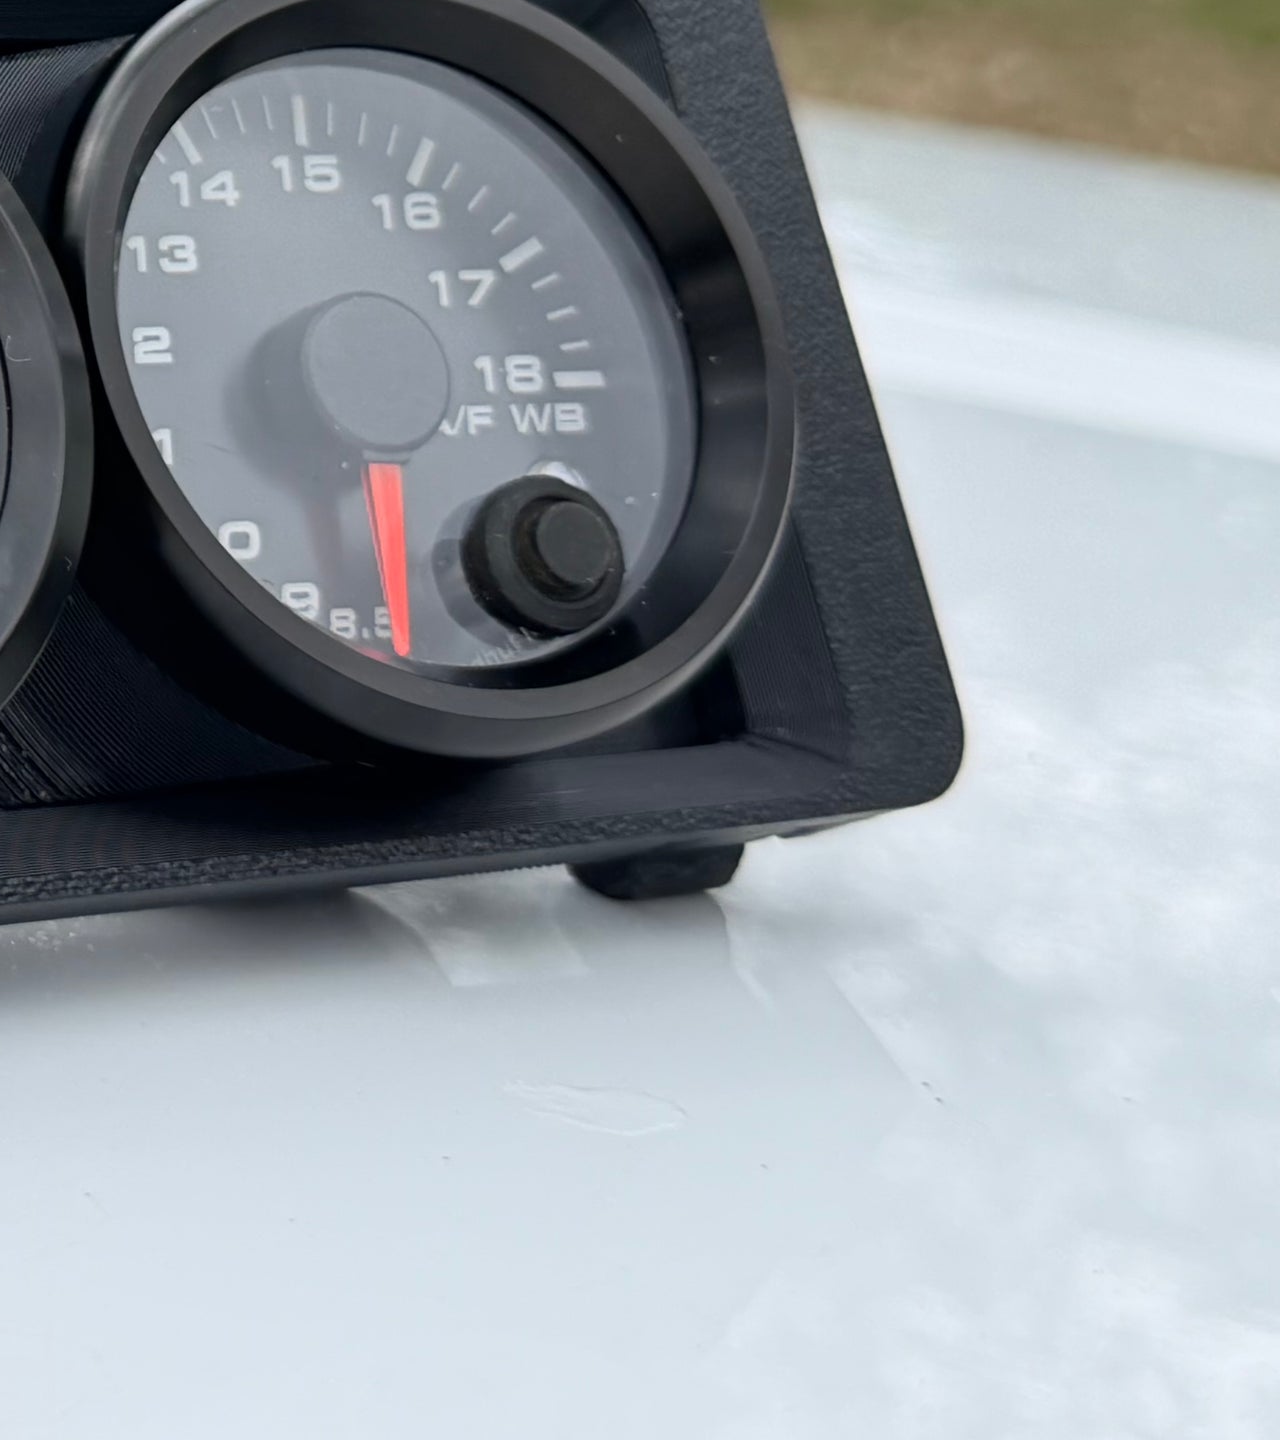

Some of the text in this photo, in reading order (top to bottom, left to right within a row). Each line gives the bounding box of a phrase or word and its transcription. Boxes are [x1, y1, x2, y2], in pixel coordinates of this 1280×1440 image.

[170, 170, 241, 207] 14
[271, 155, 341, 192] 15
[371, 193, 441, 230] 16
[126, 235, 199, 273] 13
[428, 270, 495, 307] 17
[132, 326, 173, 365] 2
[474, 355, 544, 393] 18
[508, 402, 587, 434] WB
